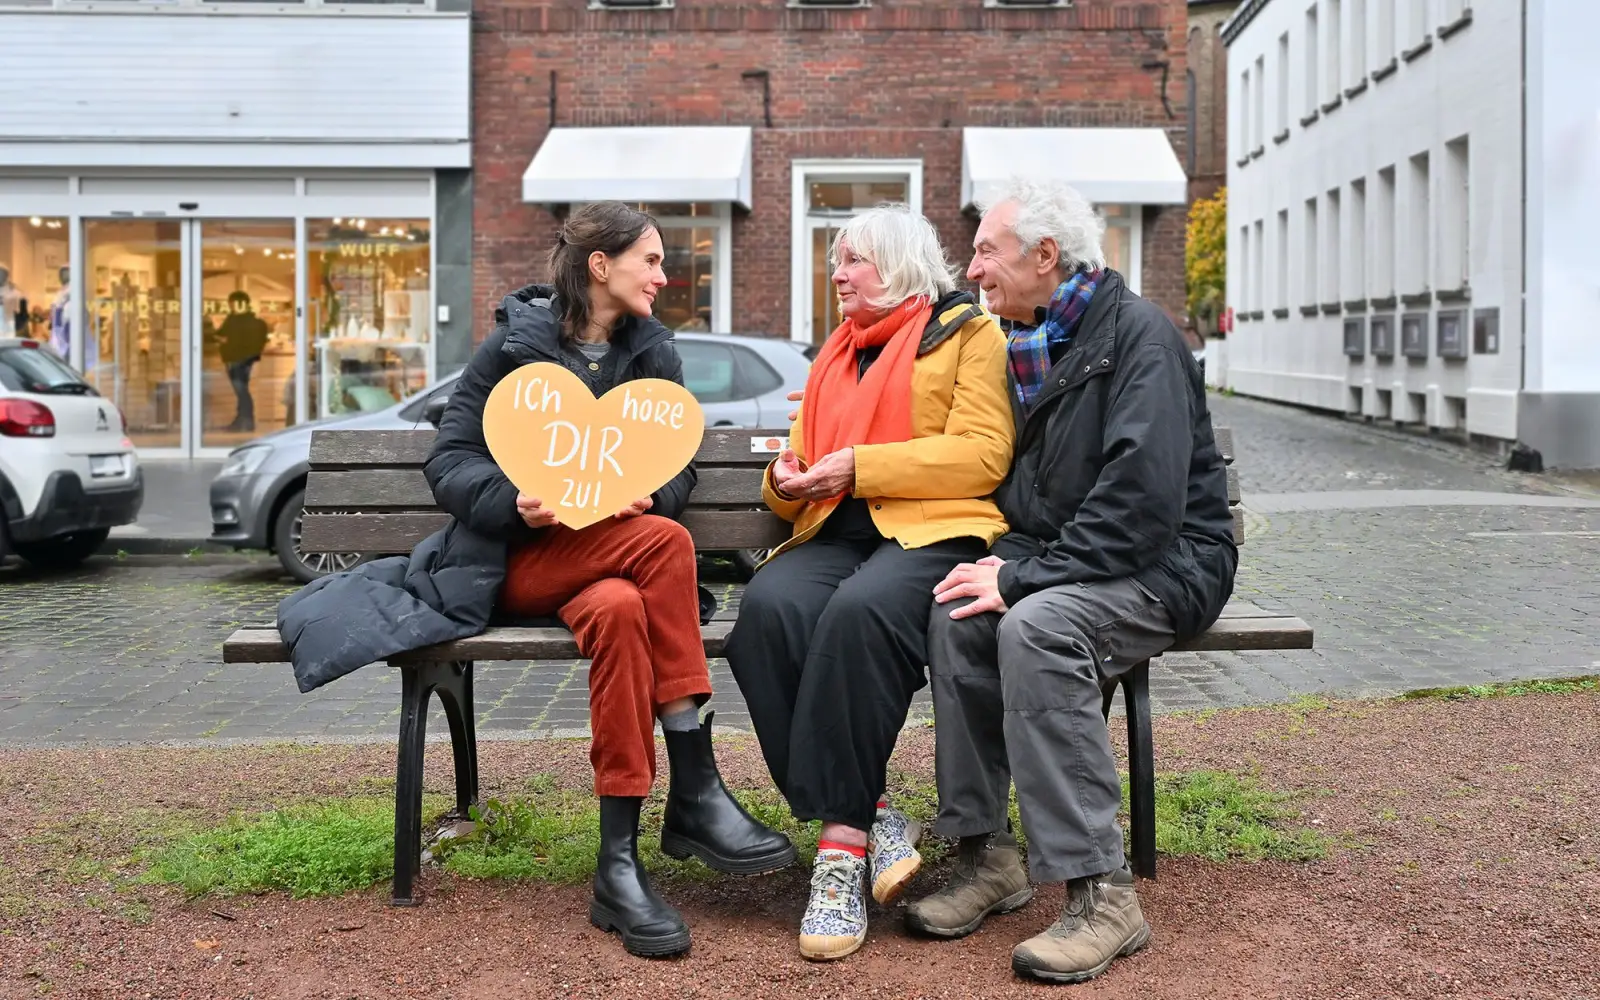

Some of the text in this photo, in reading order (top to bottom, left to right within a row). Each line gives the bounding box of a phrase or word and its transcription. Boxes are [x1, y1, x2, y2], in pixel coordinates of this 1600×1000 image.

[340, 243, 400, 257] WUFF
[542, 420, 624, 477] DIR
[559, 478, 602, 514] ZU!
